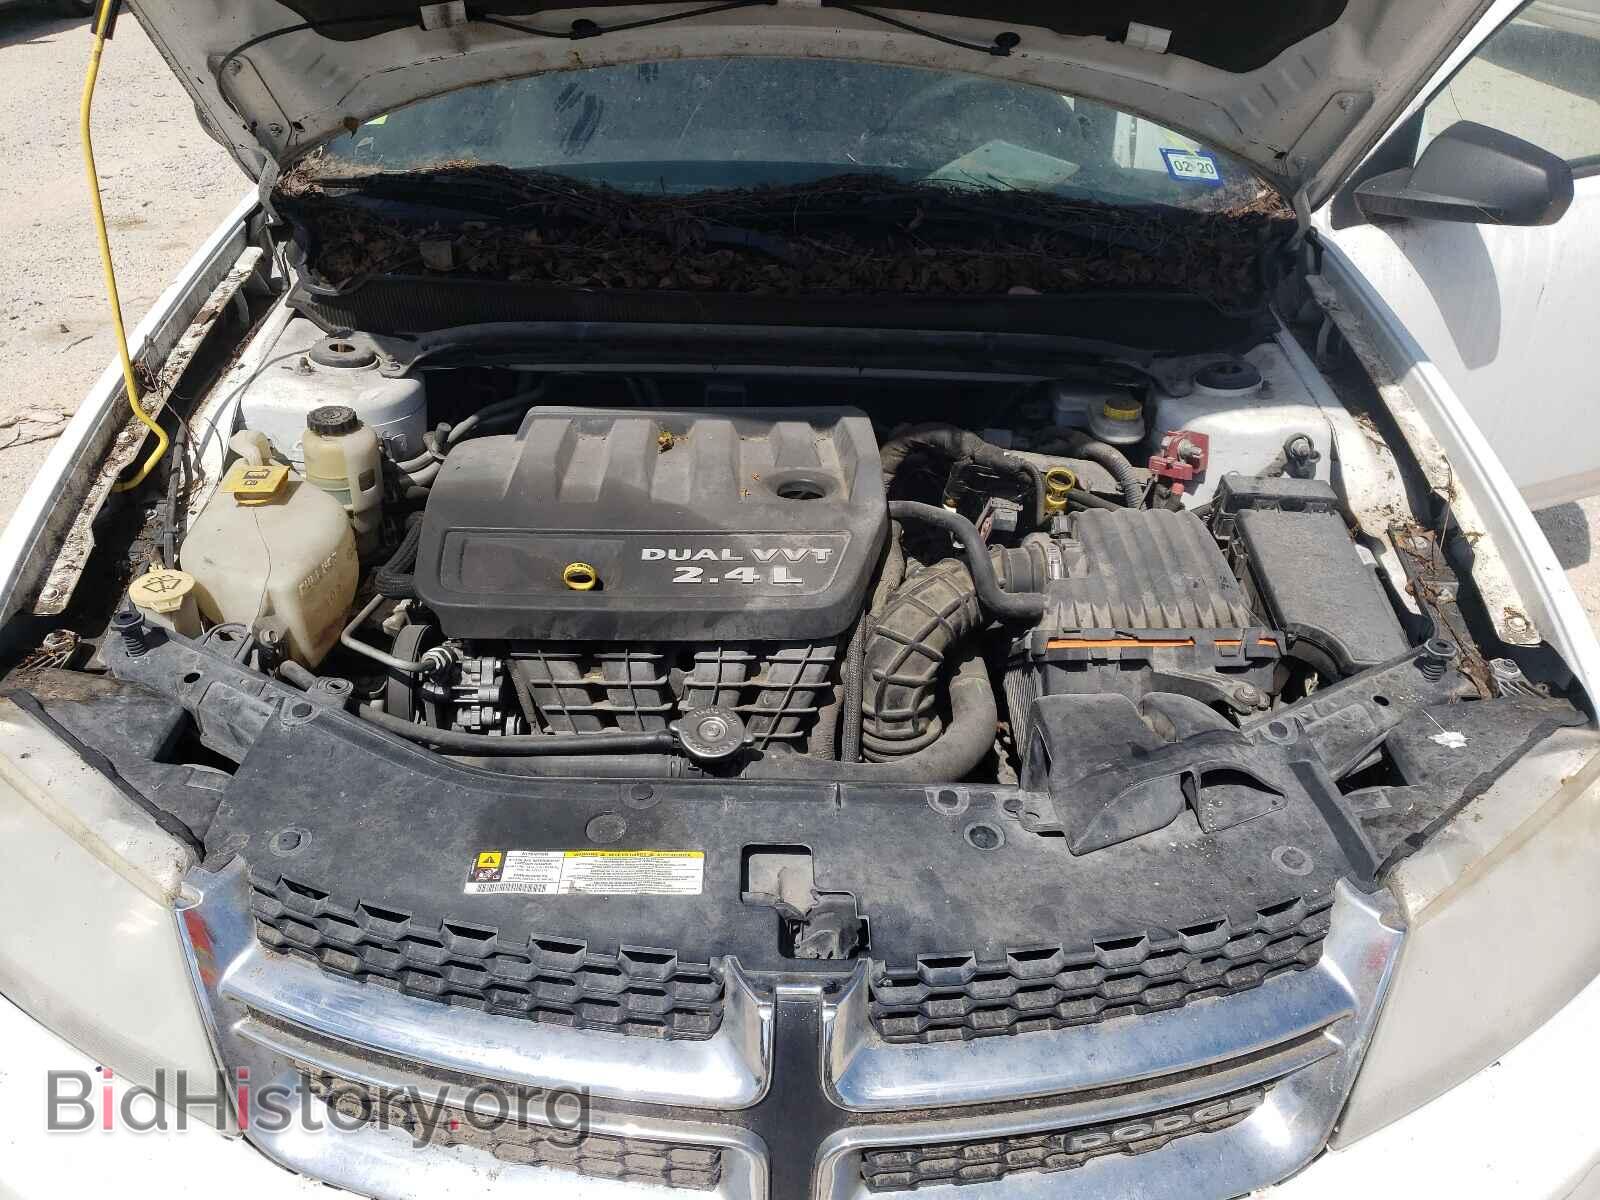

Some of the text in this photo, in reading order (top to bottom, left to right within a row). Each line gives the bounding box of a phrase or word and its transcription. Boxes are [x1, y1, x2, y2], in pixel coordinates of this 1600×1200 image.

[1174, 160, 1214, 174] 02 20
[640, 548, 833, 563] DUAL VVT
